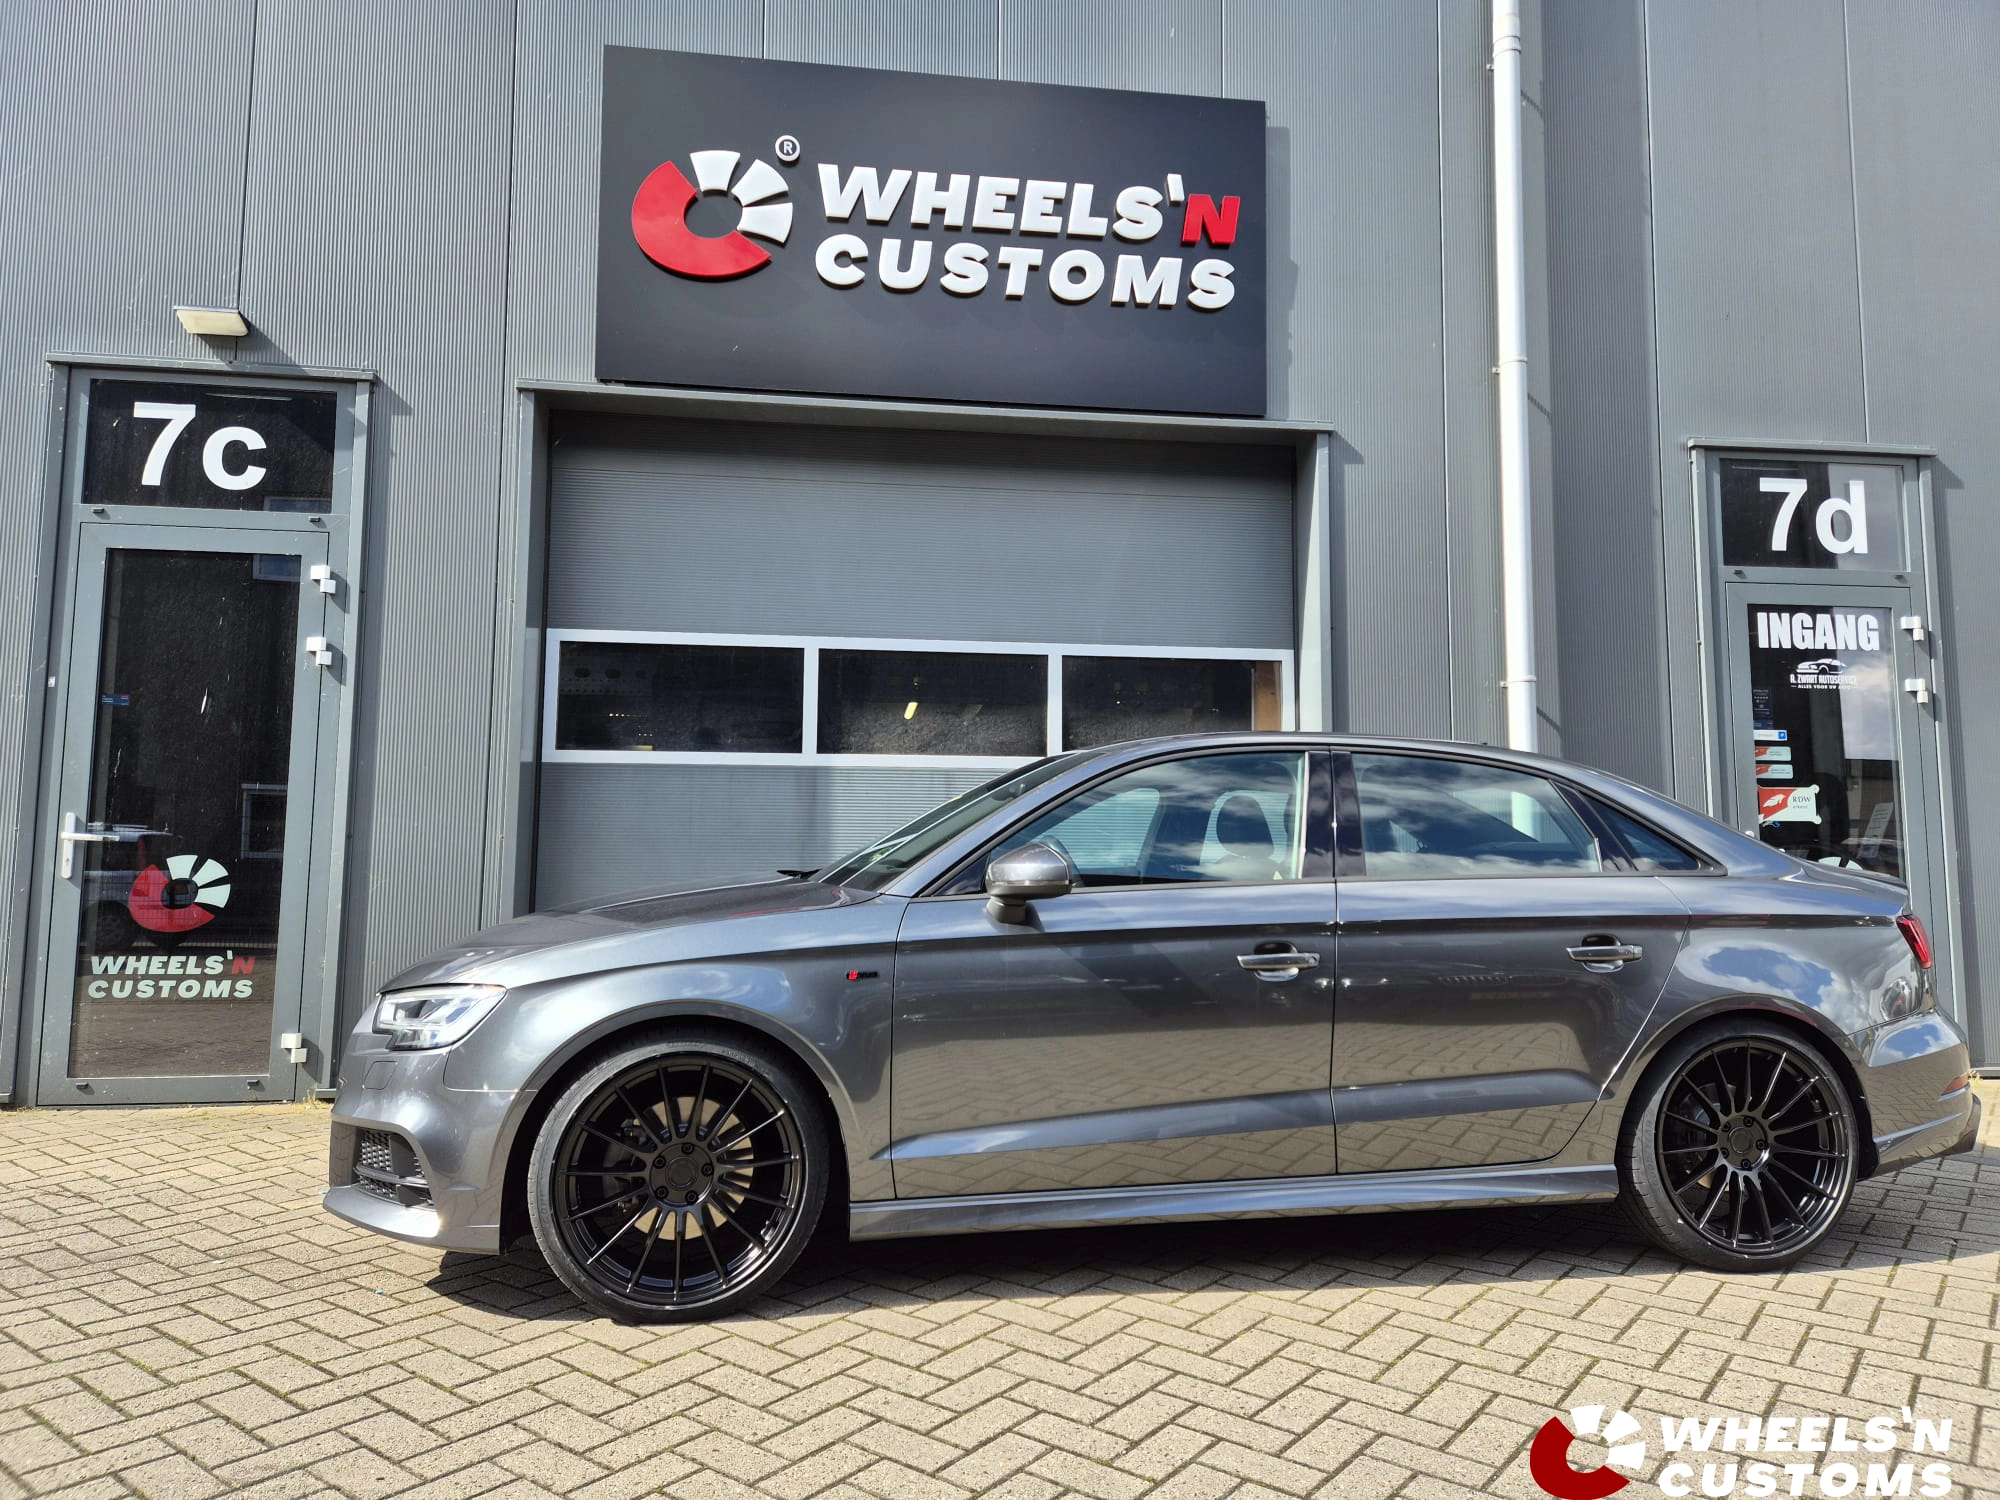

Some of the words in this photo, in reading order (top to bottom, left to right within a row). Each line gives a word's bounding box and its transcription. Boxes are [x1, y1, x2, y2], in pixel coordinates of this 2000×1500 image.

[817, 162, 1241, 245] WHEELS'N
[815, 233, 1236, 309] CUSTOMS
[1759, 477, 1869, 554] 7d
[1757, 612, 1880, 651] INGANG
[1792, 795, 1812, 803] RDW
[91, 950, 256, 976] WHEELS'N
[87, 979, 253, 999] CUSTOMS
